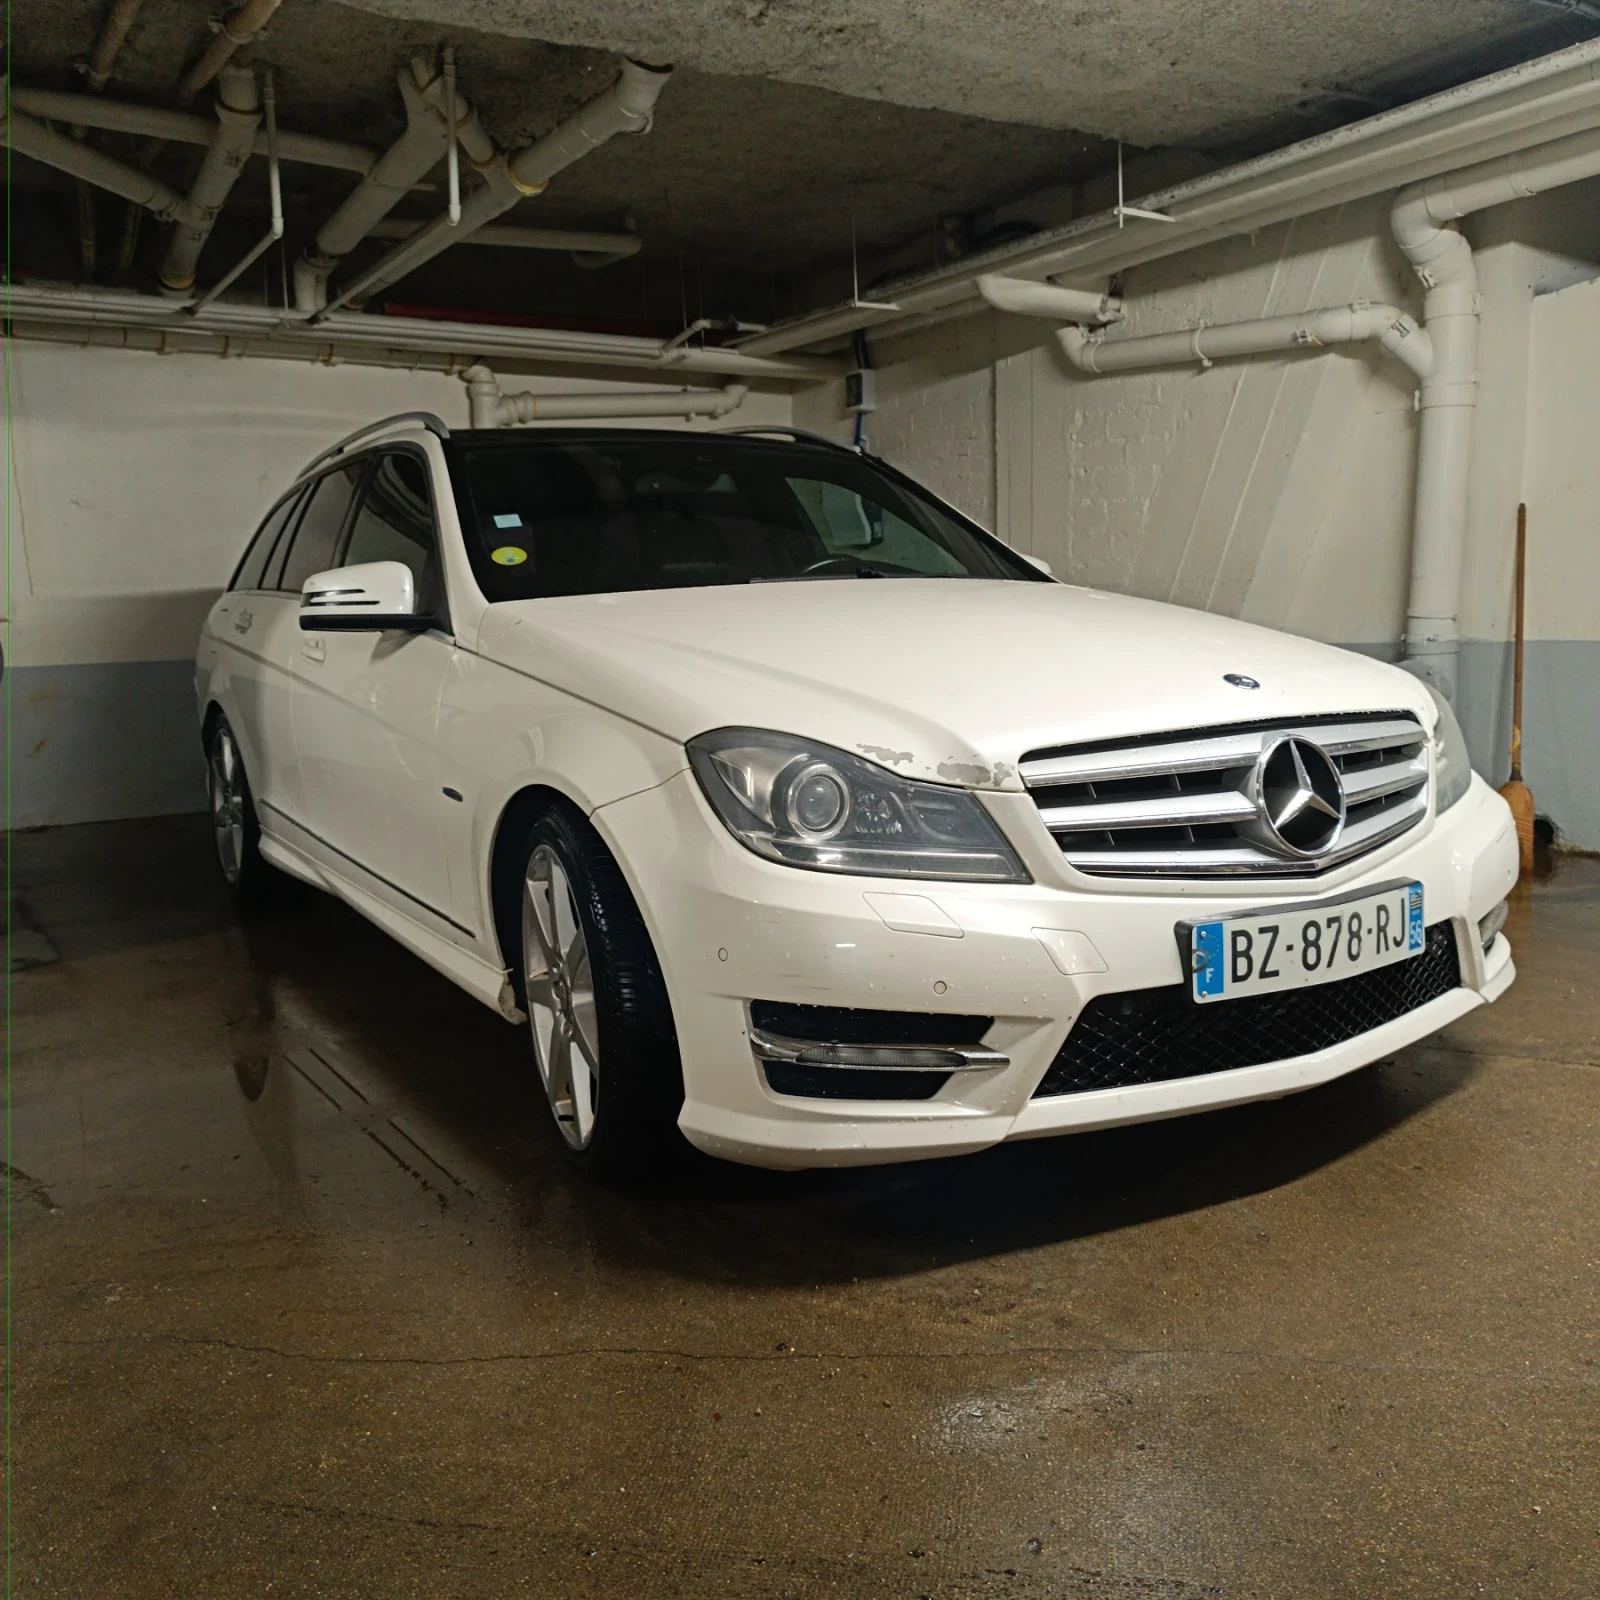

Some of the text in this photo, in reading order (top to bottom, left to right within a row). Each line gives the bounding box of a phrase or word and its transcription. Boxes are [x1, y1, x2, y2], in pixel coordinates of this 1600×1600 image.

[1231, 898, 1406, 983] BZ-878-RJ
[1410, 920, 1423, 944] 56
[1206, 968, 1214, 983] F
